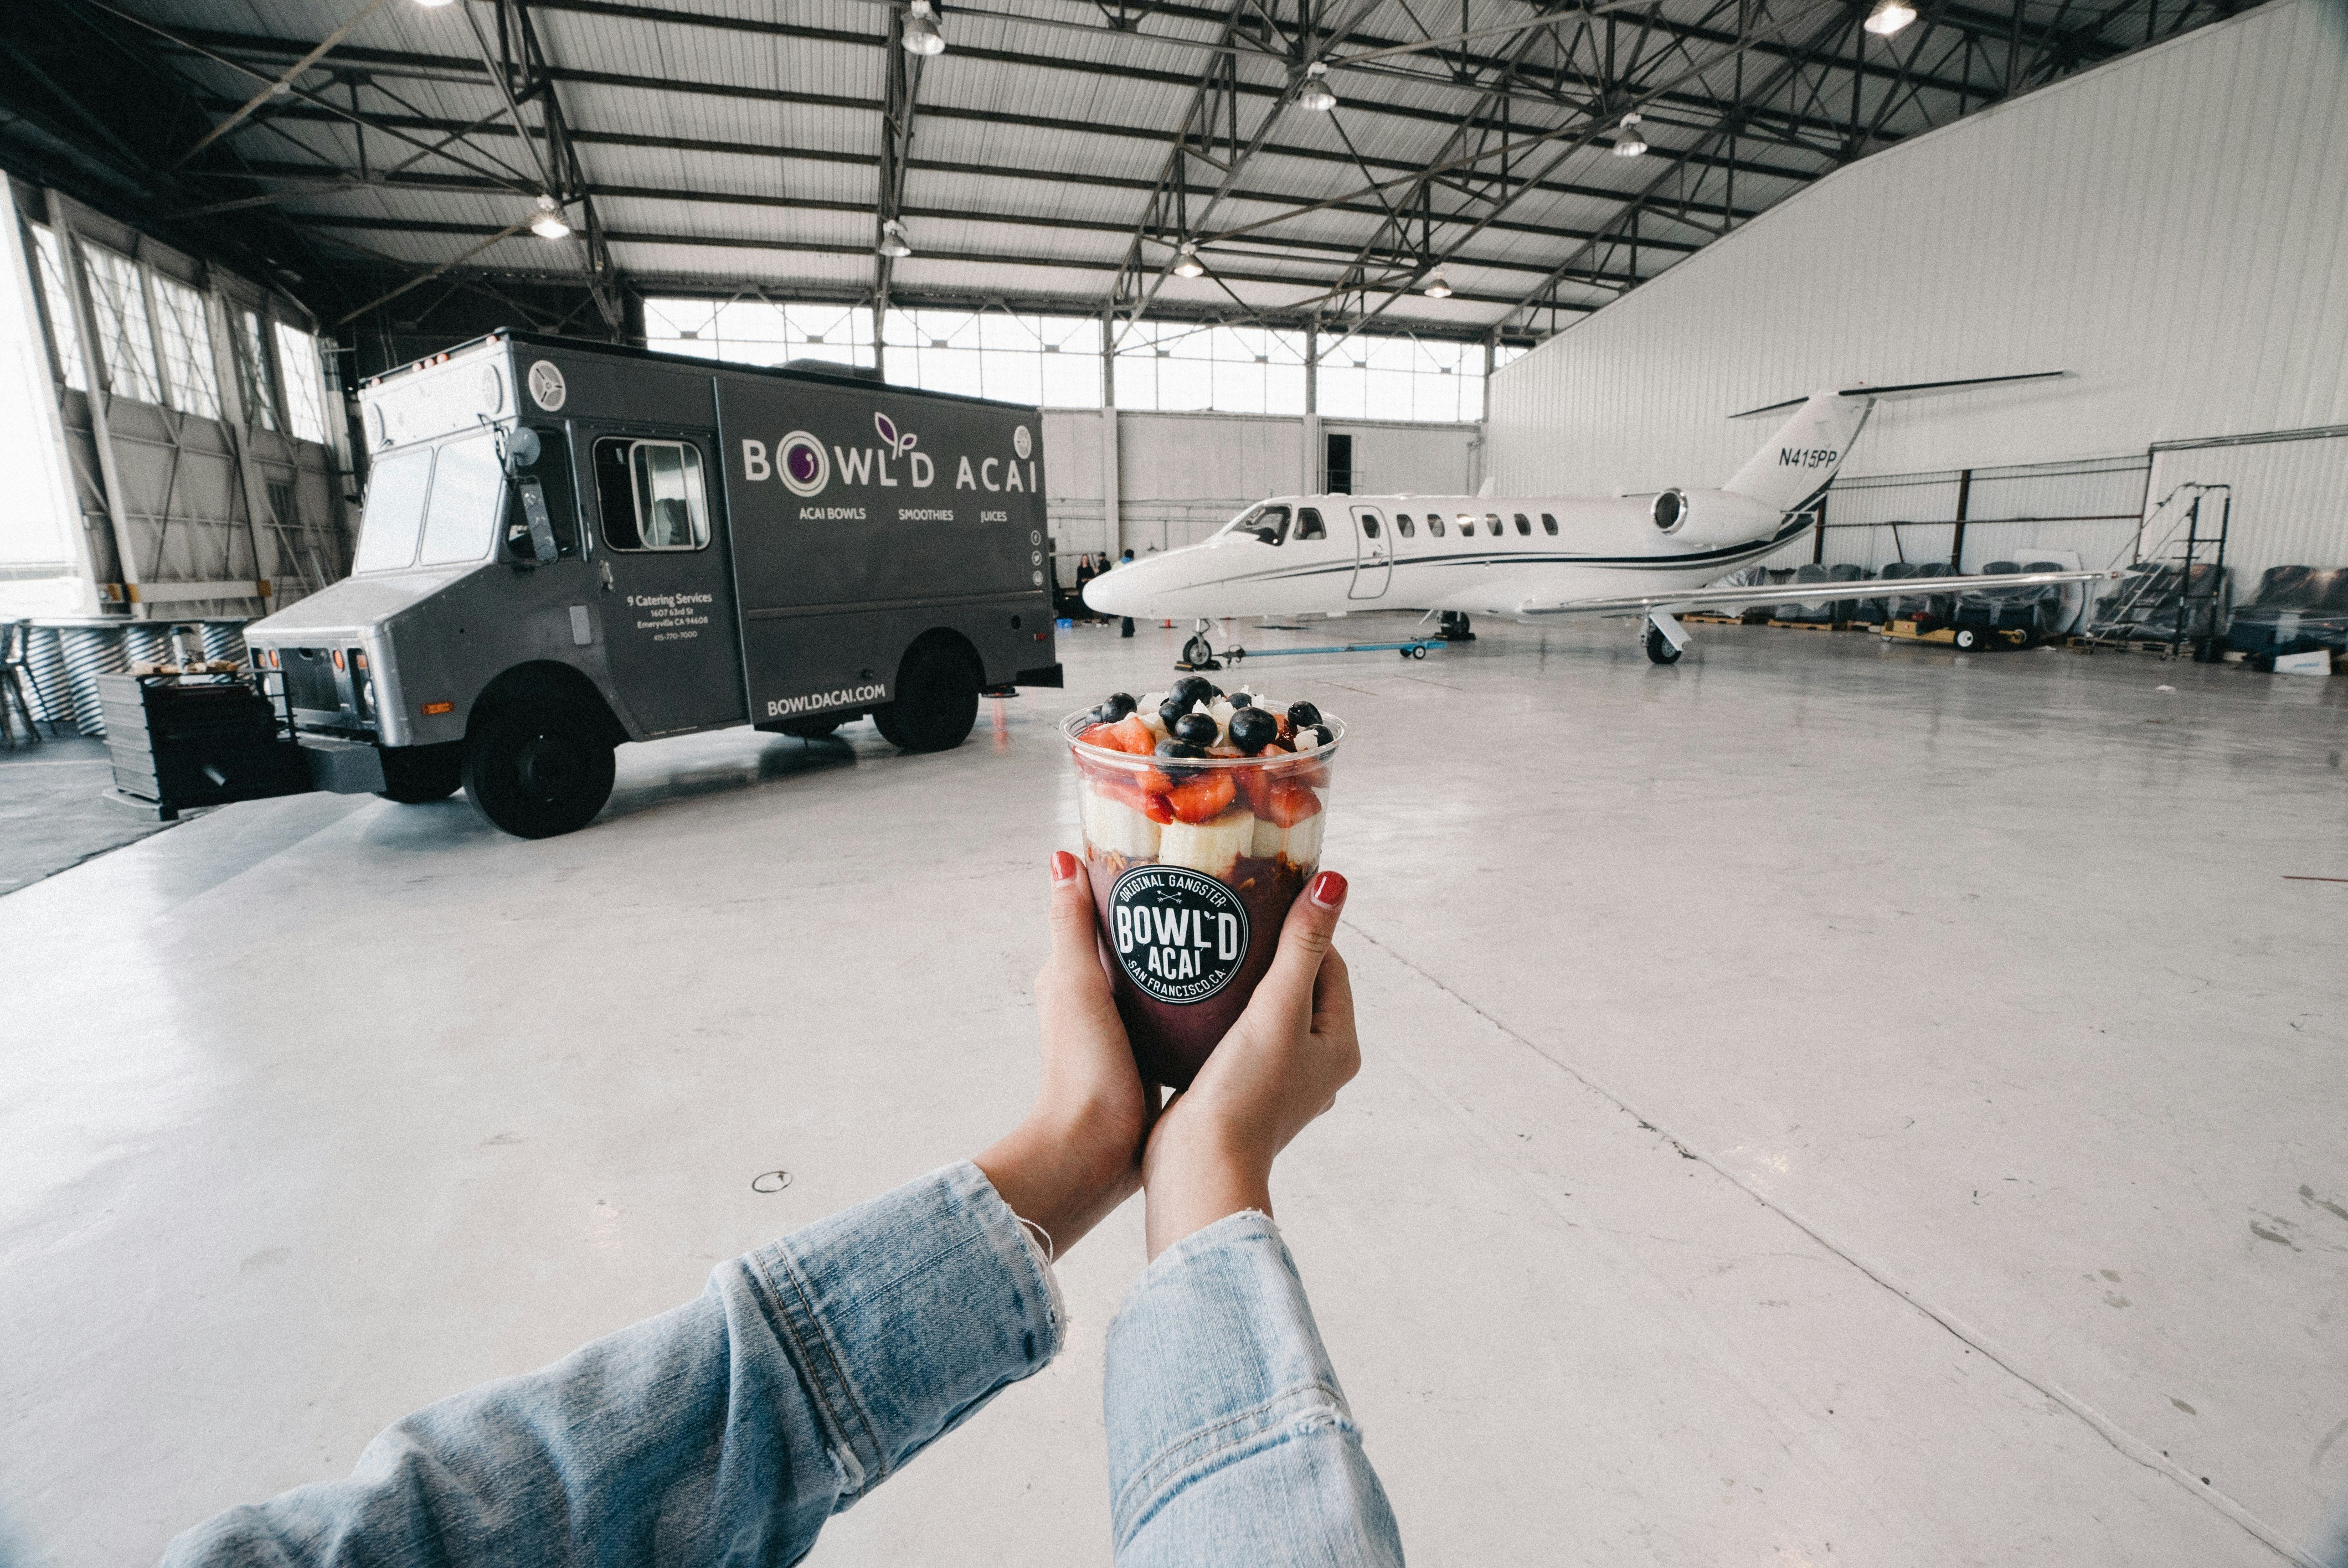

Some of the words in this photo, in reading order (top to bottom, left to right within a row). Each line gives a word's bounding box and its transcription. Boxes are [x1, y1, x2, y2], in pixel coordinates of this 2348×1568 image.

[1779, 447, 1837, 468] N415PP
[955, 455, 1037, 493] ACAI
[799, 507, 825, 520] ACAI
[827, 507, 867, 520] BOWLS
[898, 508, 954, 521] SMOOTHIES
[980, 510, 1007, 523] JUICES
[635, 594, 676, 608] Catering
[676, 592, 713, 605] Services
[637, 618, 674, 630] Emeryville
[674, 618, 685, 626] CA
[767, 683, 886, 717] BOWLDACAI.COM
[1119, 874, 1165, 902] ORIGINAL
[1168, 874, 1227, 907] GANGSTER
[1128, 960, 1147, 983] SAN
[1147, 946, 1201, 980] ACAI
